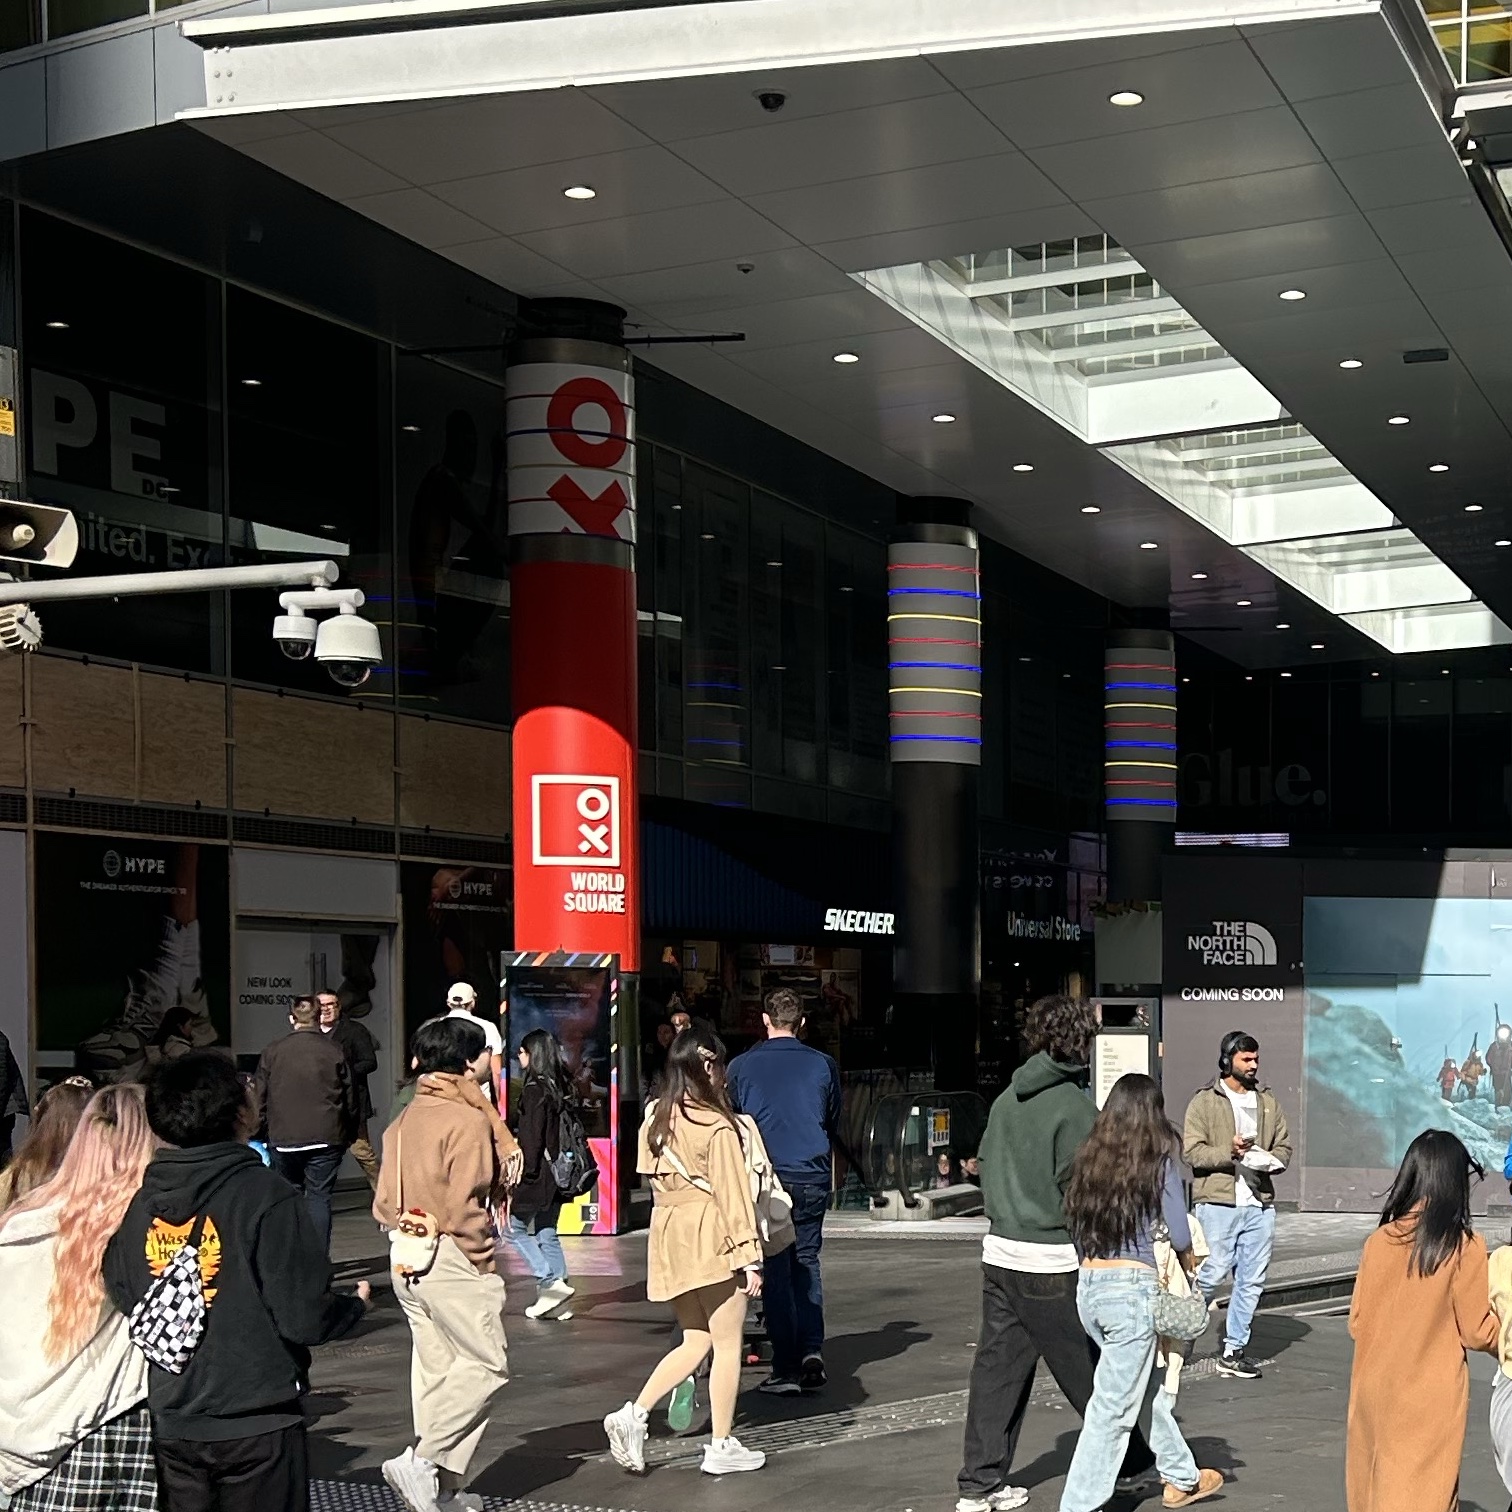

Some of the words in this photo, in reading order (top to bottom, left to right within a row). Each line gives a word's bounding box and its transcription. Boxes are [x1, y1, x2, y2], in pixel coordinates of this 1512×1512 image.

[125, 856, 166, 874] HYPE
[463, 881, 493, 896] HYPE
[571, 872, 625, 892] WORLD
[563, 892, 626, 914] SQUARE
[1007, 911, 1054, 940] Universal
[1055, 915, 1080, 941] Store
[1211, 921, 1245, 936] THE
[1187, 935, 1245, 951] NORTH
[1203, 950, 1245, 966] FACE
[247, 976, 268, 988] NEW
[269, 977, 292, 988] LOOK
[239, 994, 275, 1005] COMING
[1181, 987, 1240, 1001] COMING
[1241, 987, 1284, 1001] SOON
